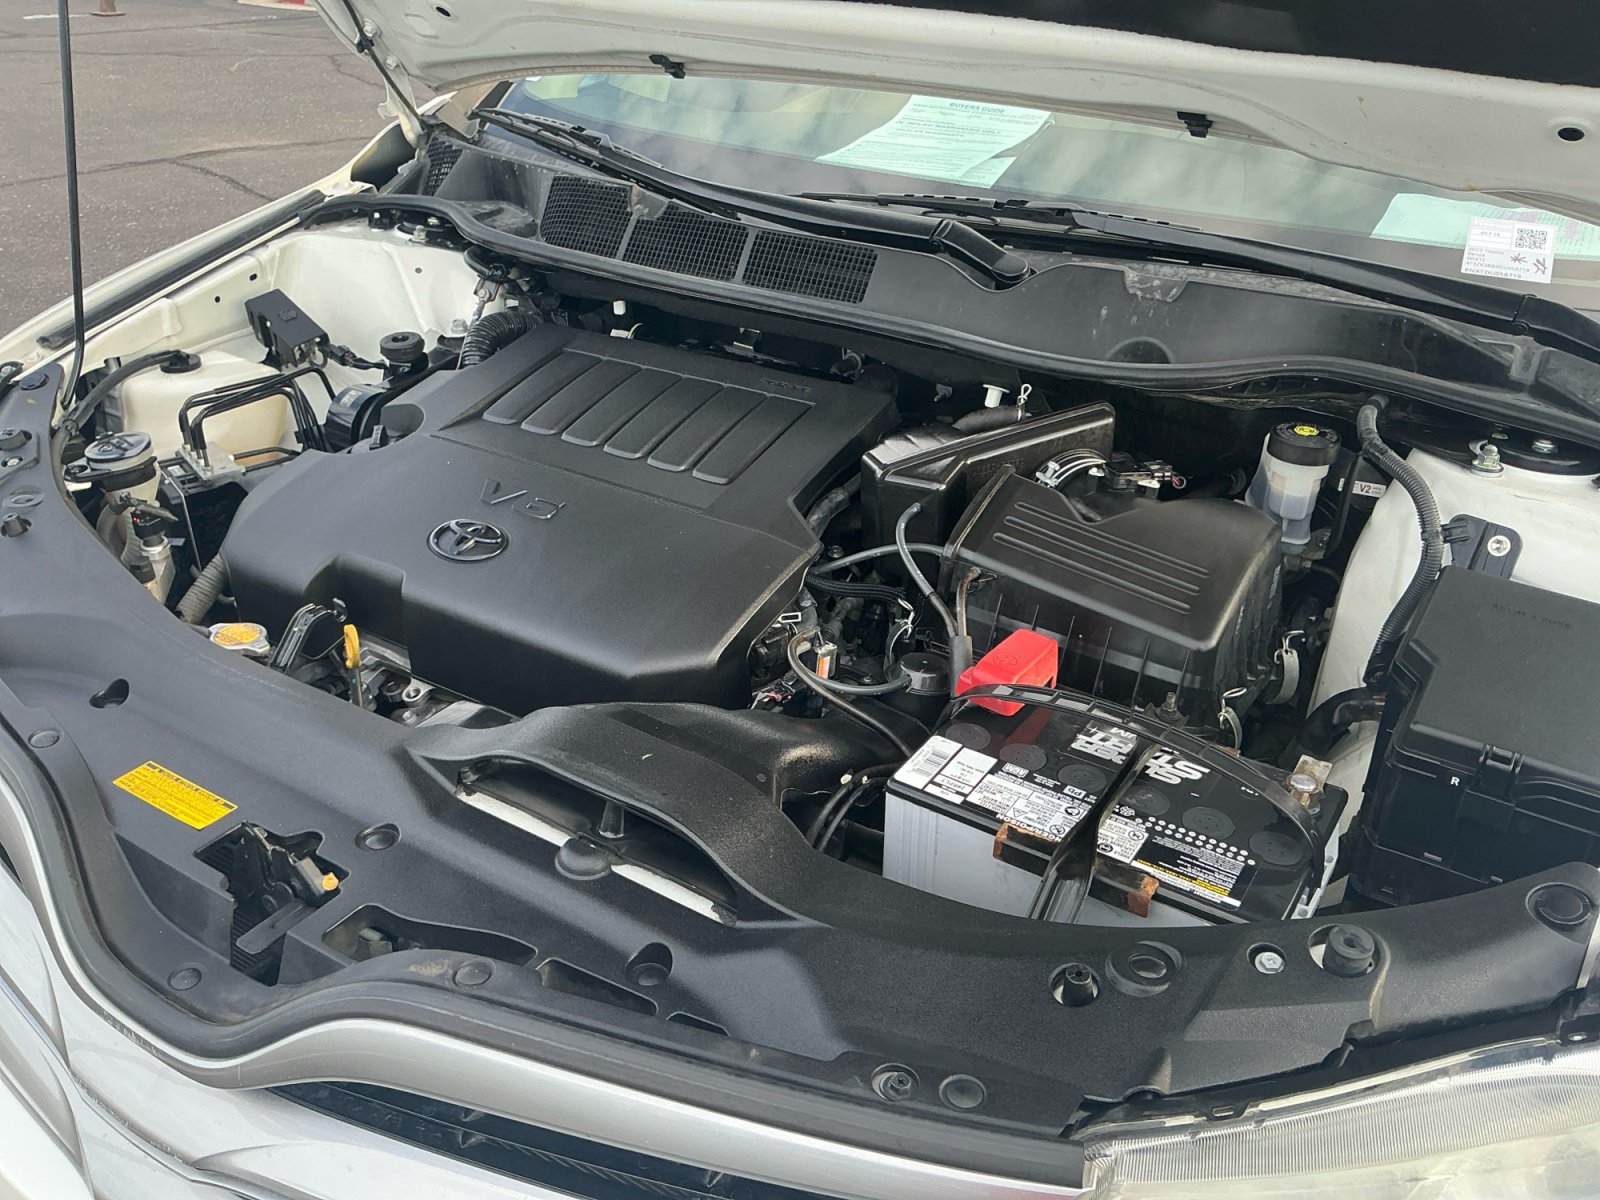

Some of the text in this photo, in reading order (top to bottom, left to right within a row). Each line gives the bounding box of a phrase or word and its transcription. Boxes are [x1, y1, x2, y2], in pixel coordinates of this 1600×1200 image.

[939, 778, 966, 790] 24RPLT
[1450, 776, 1460, 786] R
[1066, 787, 1082, 796] Pb
[994, 813, 1063, 842] NGER/POISON
